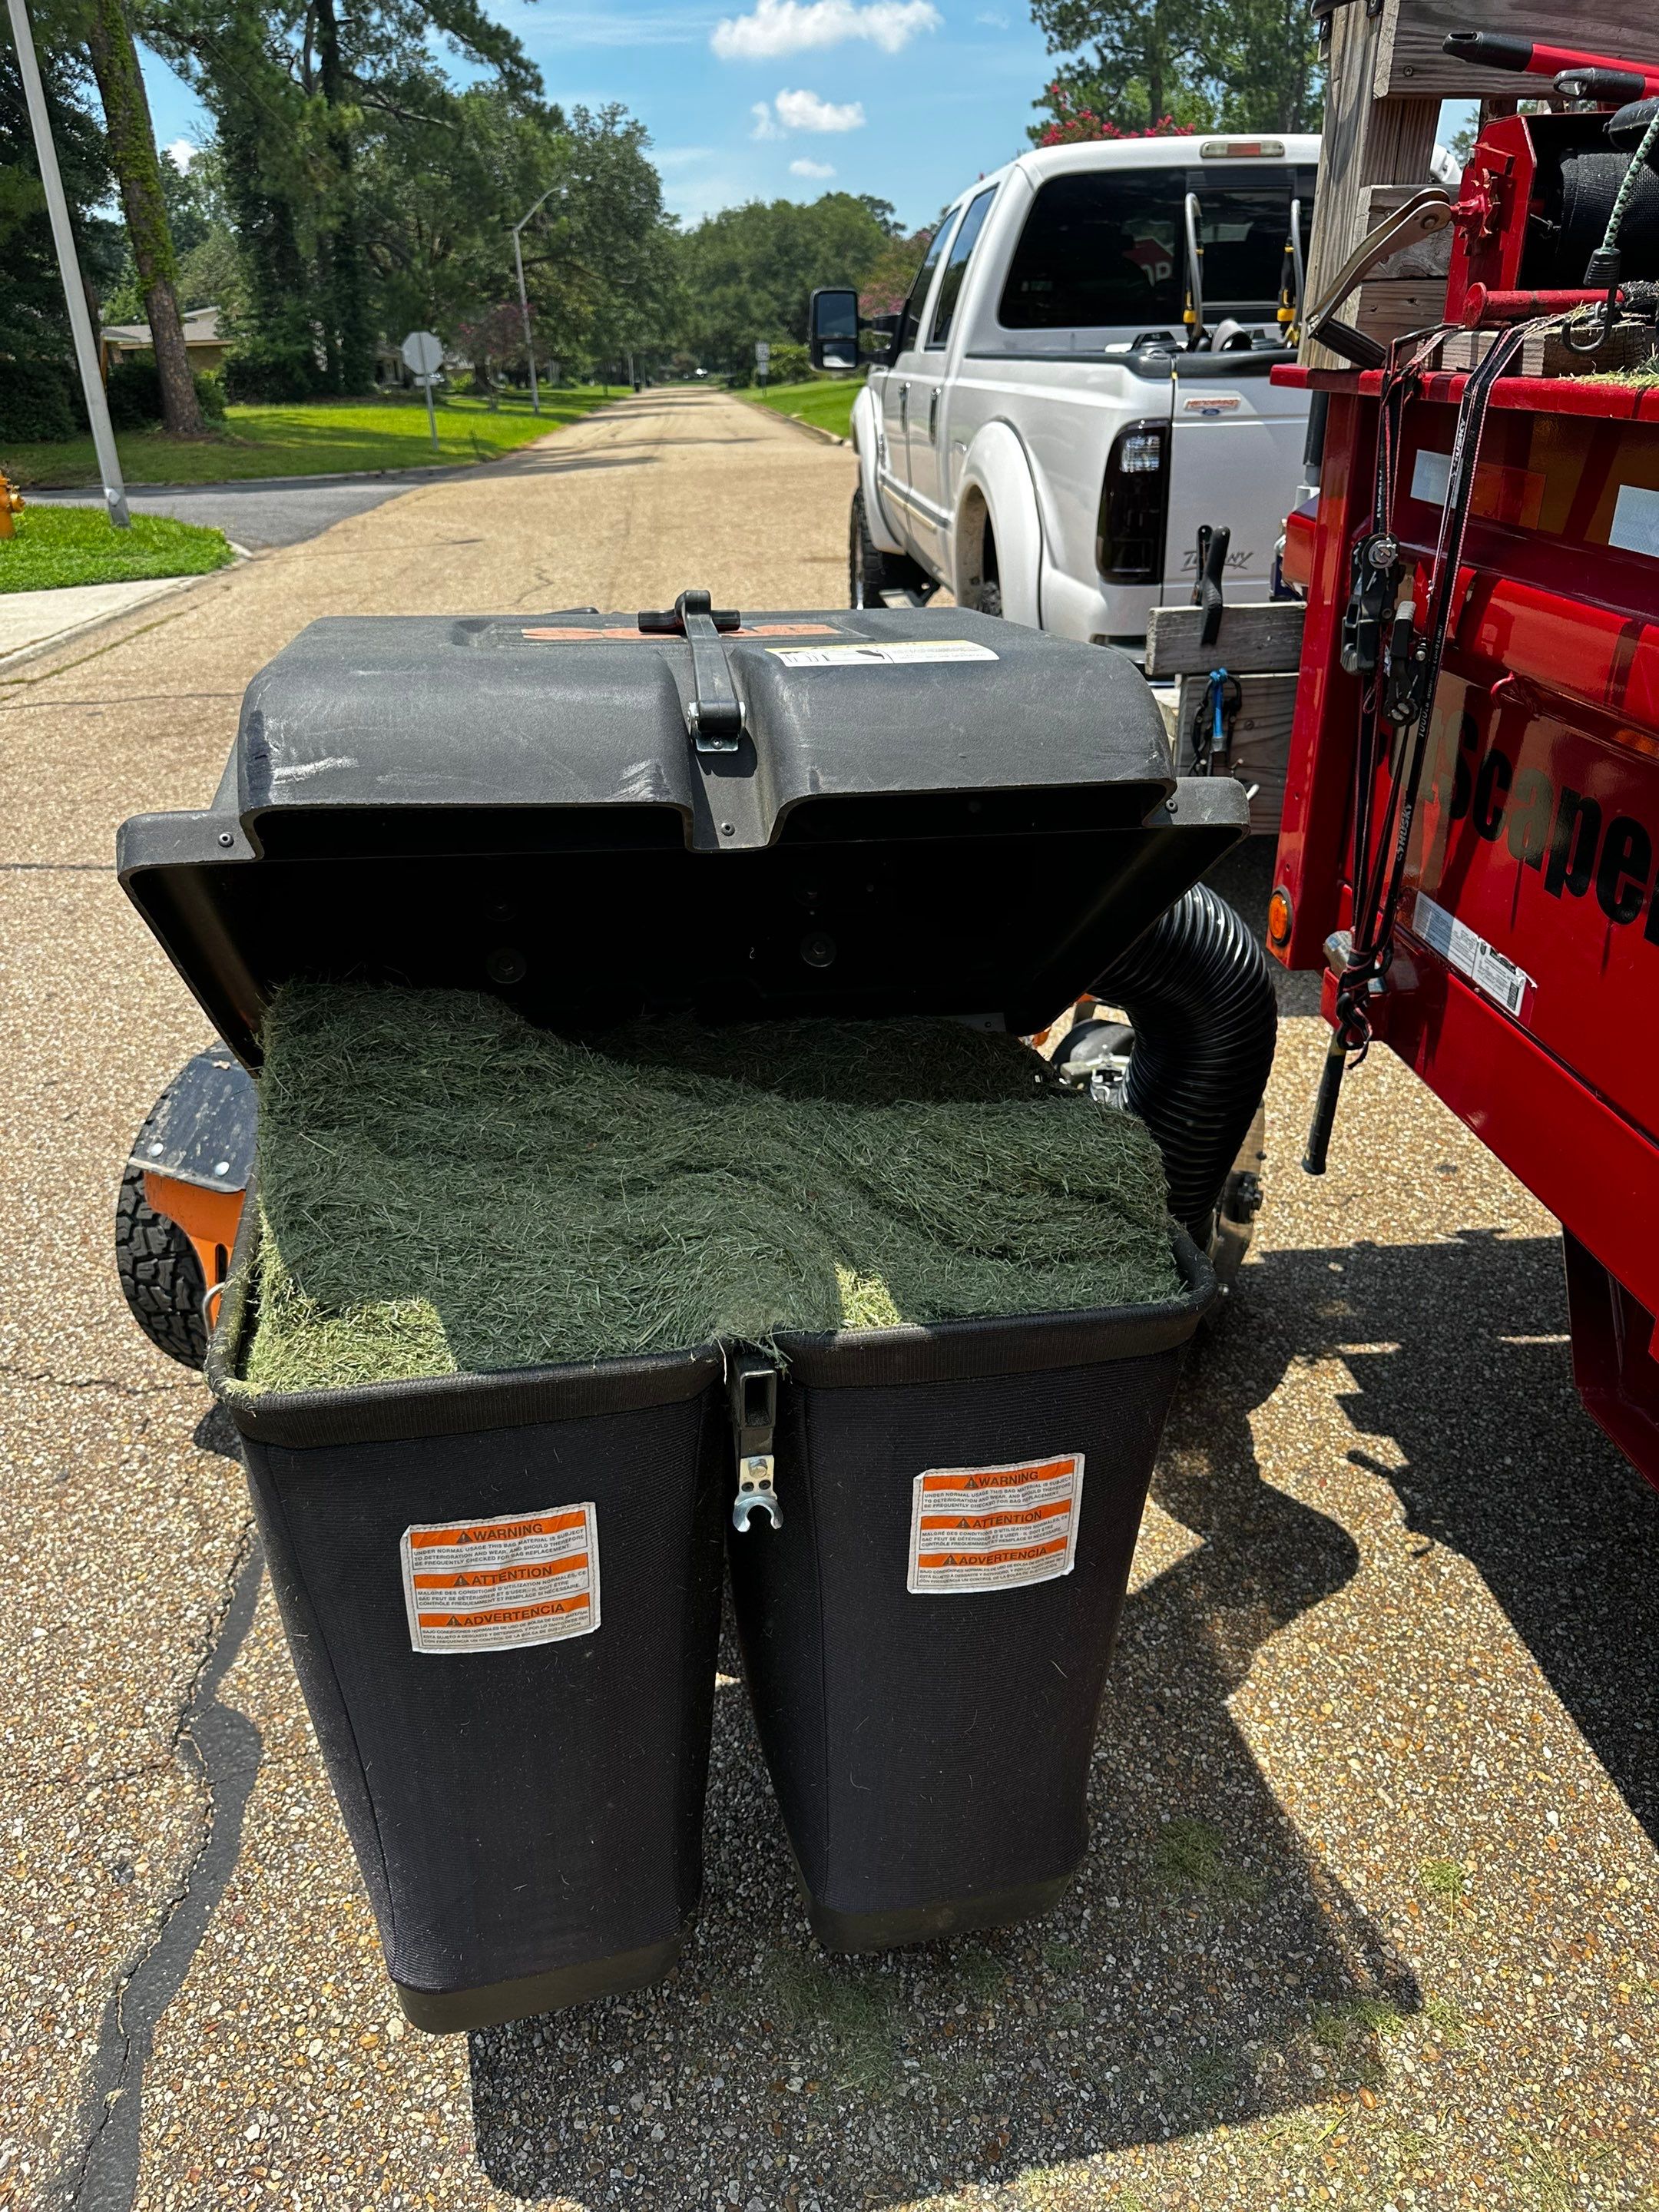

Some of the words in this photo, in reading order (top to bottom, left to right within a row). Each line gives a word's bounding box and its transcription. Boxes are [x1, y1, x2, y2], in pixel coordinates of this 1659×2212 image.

[1398, 803, 1412, 846] HUSKY
[979, 1472, 1038, 1486] WARNING
[1017, 1484, 1041, 1492] MATERIAL
[1049, 1476, 1071, 1485] SUBJECT
[1043, 1482, 1071, 1492] THEREFORE
[973, 1510, 1041, 1528] ATTENTION
[474, 1524, 543, 1541] WARNING
[550, 1535, 584, 1546] THEREFORE
[557, 1528, 584, 1539] SUBJECT
[959, 1547, 1046, 1565] ADVERTENCIA
[472, 1566, 552, 1585] ATTENTION
[464, 1604, 565, 1626] ADVERTENCIA
